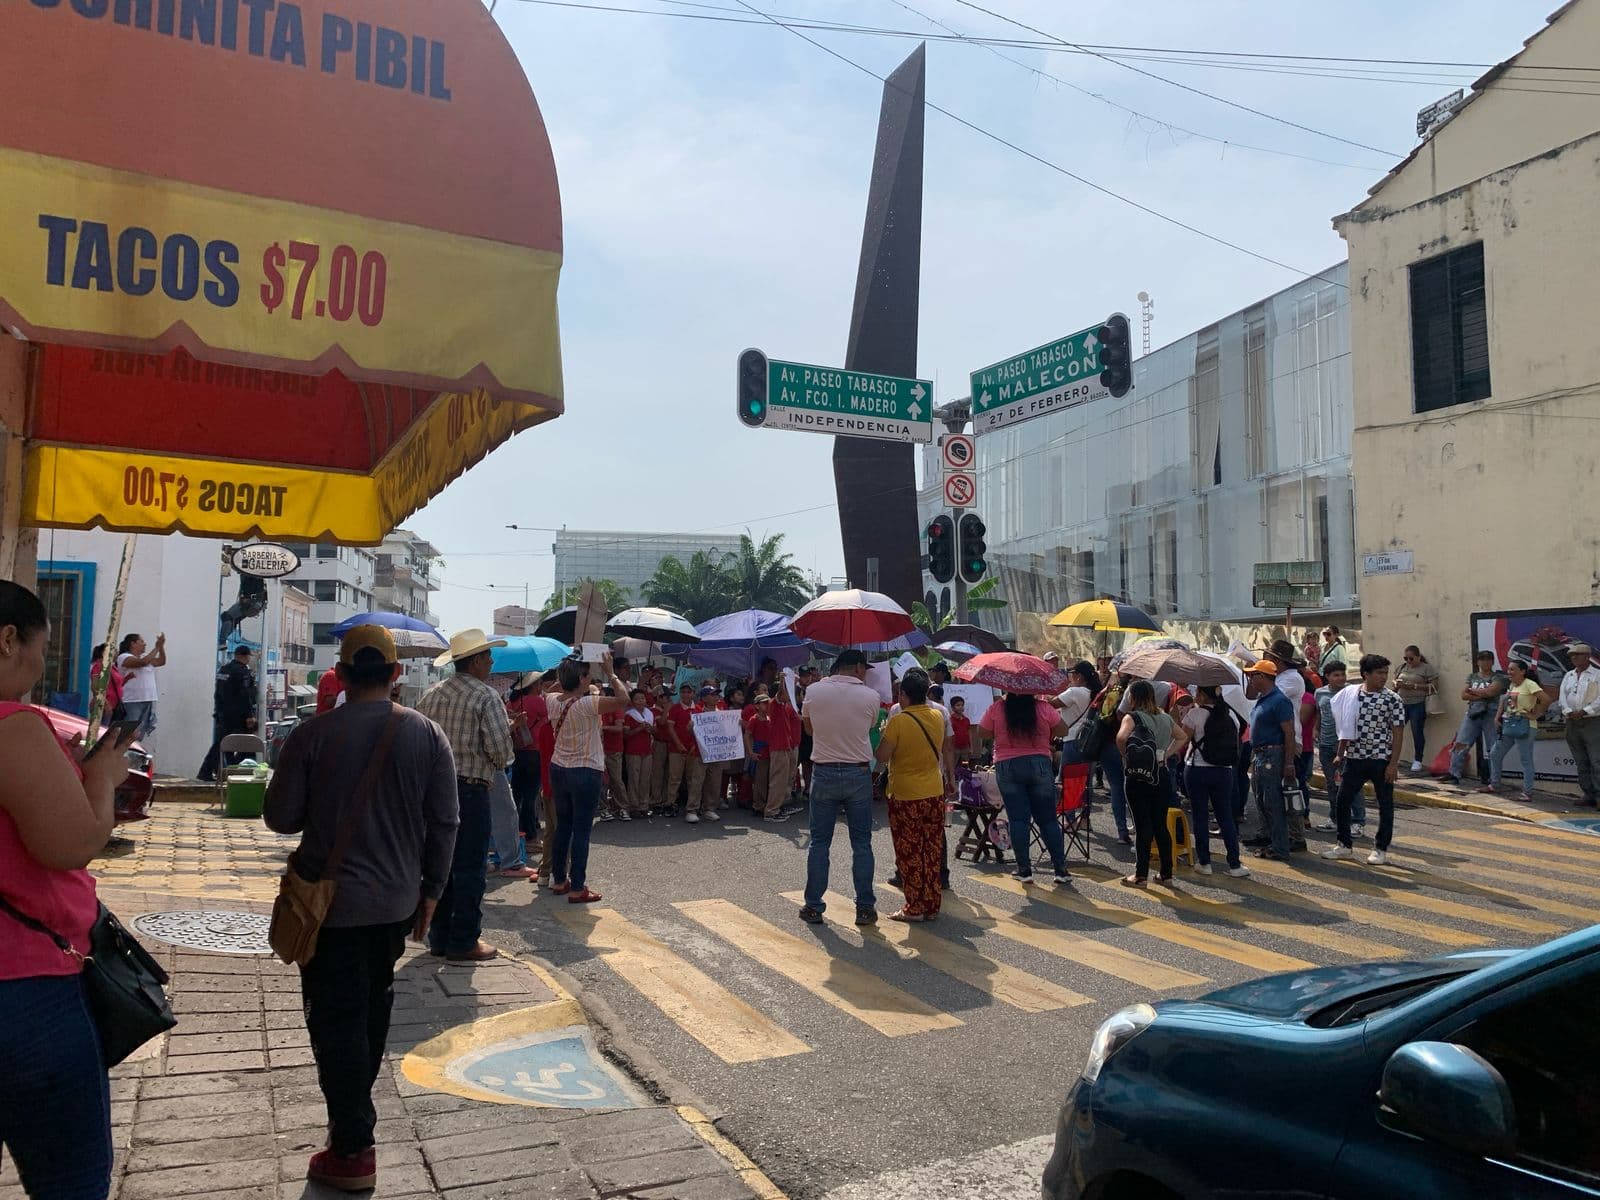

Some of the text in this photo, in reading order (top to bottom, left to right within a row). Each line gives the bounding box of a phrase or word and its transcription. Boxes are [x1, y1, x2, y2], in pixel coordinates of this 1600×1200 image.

[29, 0, 453, 101] INITA PIBIL
[38, 214, 387, 327] TACOS $7.00
[781, 367, 897, 396] Av. PASEO TABASCO
[998, 359, 1026, 382] PASEO
[1031, 341, 1073, 370] TABASCO
[999, 353, 1097, 401] MALECON
[781, 386, 800, 403] Av.
[805, 390, 832, 408] FCO.
[850, 396, 897, 414] MADERO
[990, 385, 1089, 425] 27 DE FEBRERO
[789, 413, 910, 434] INDEPENDENCIA
[249, 558, 285, 570] GALERIA
